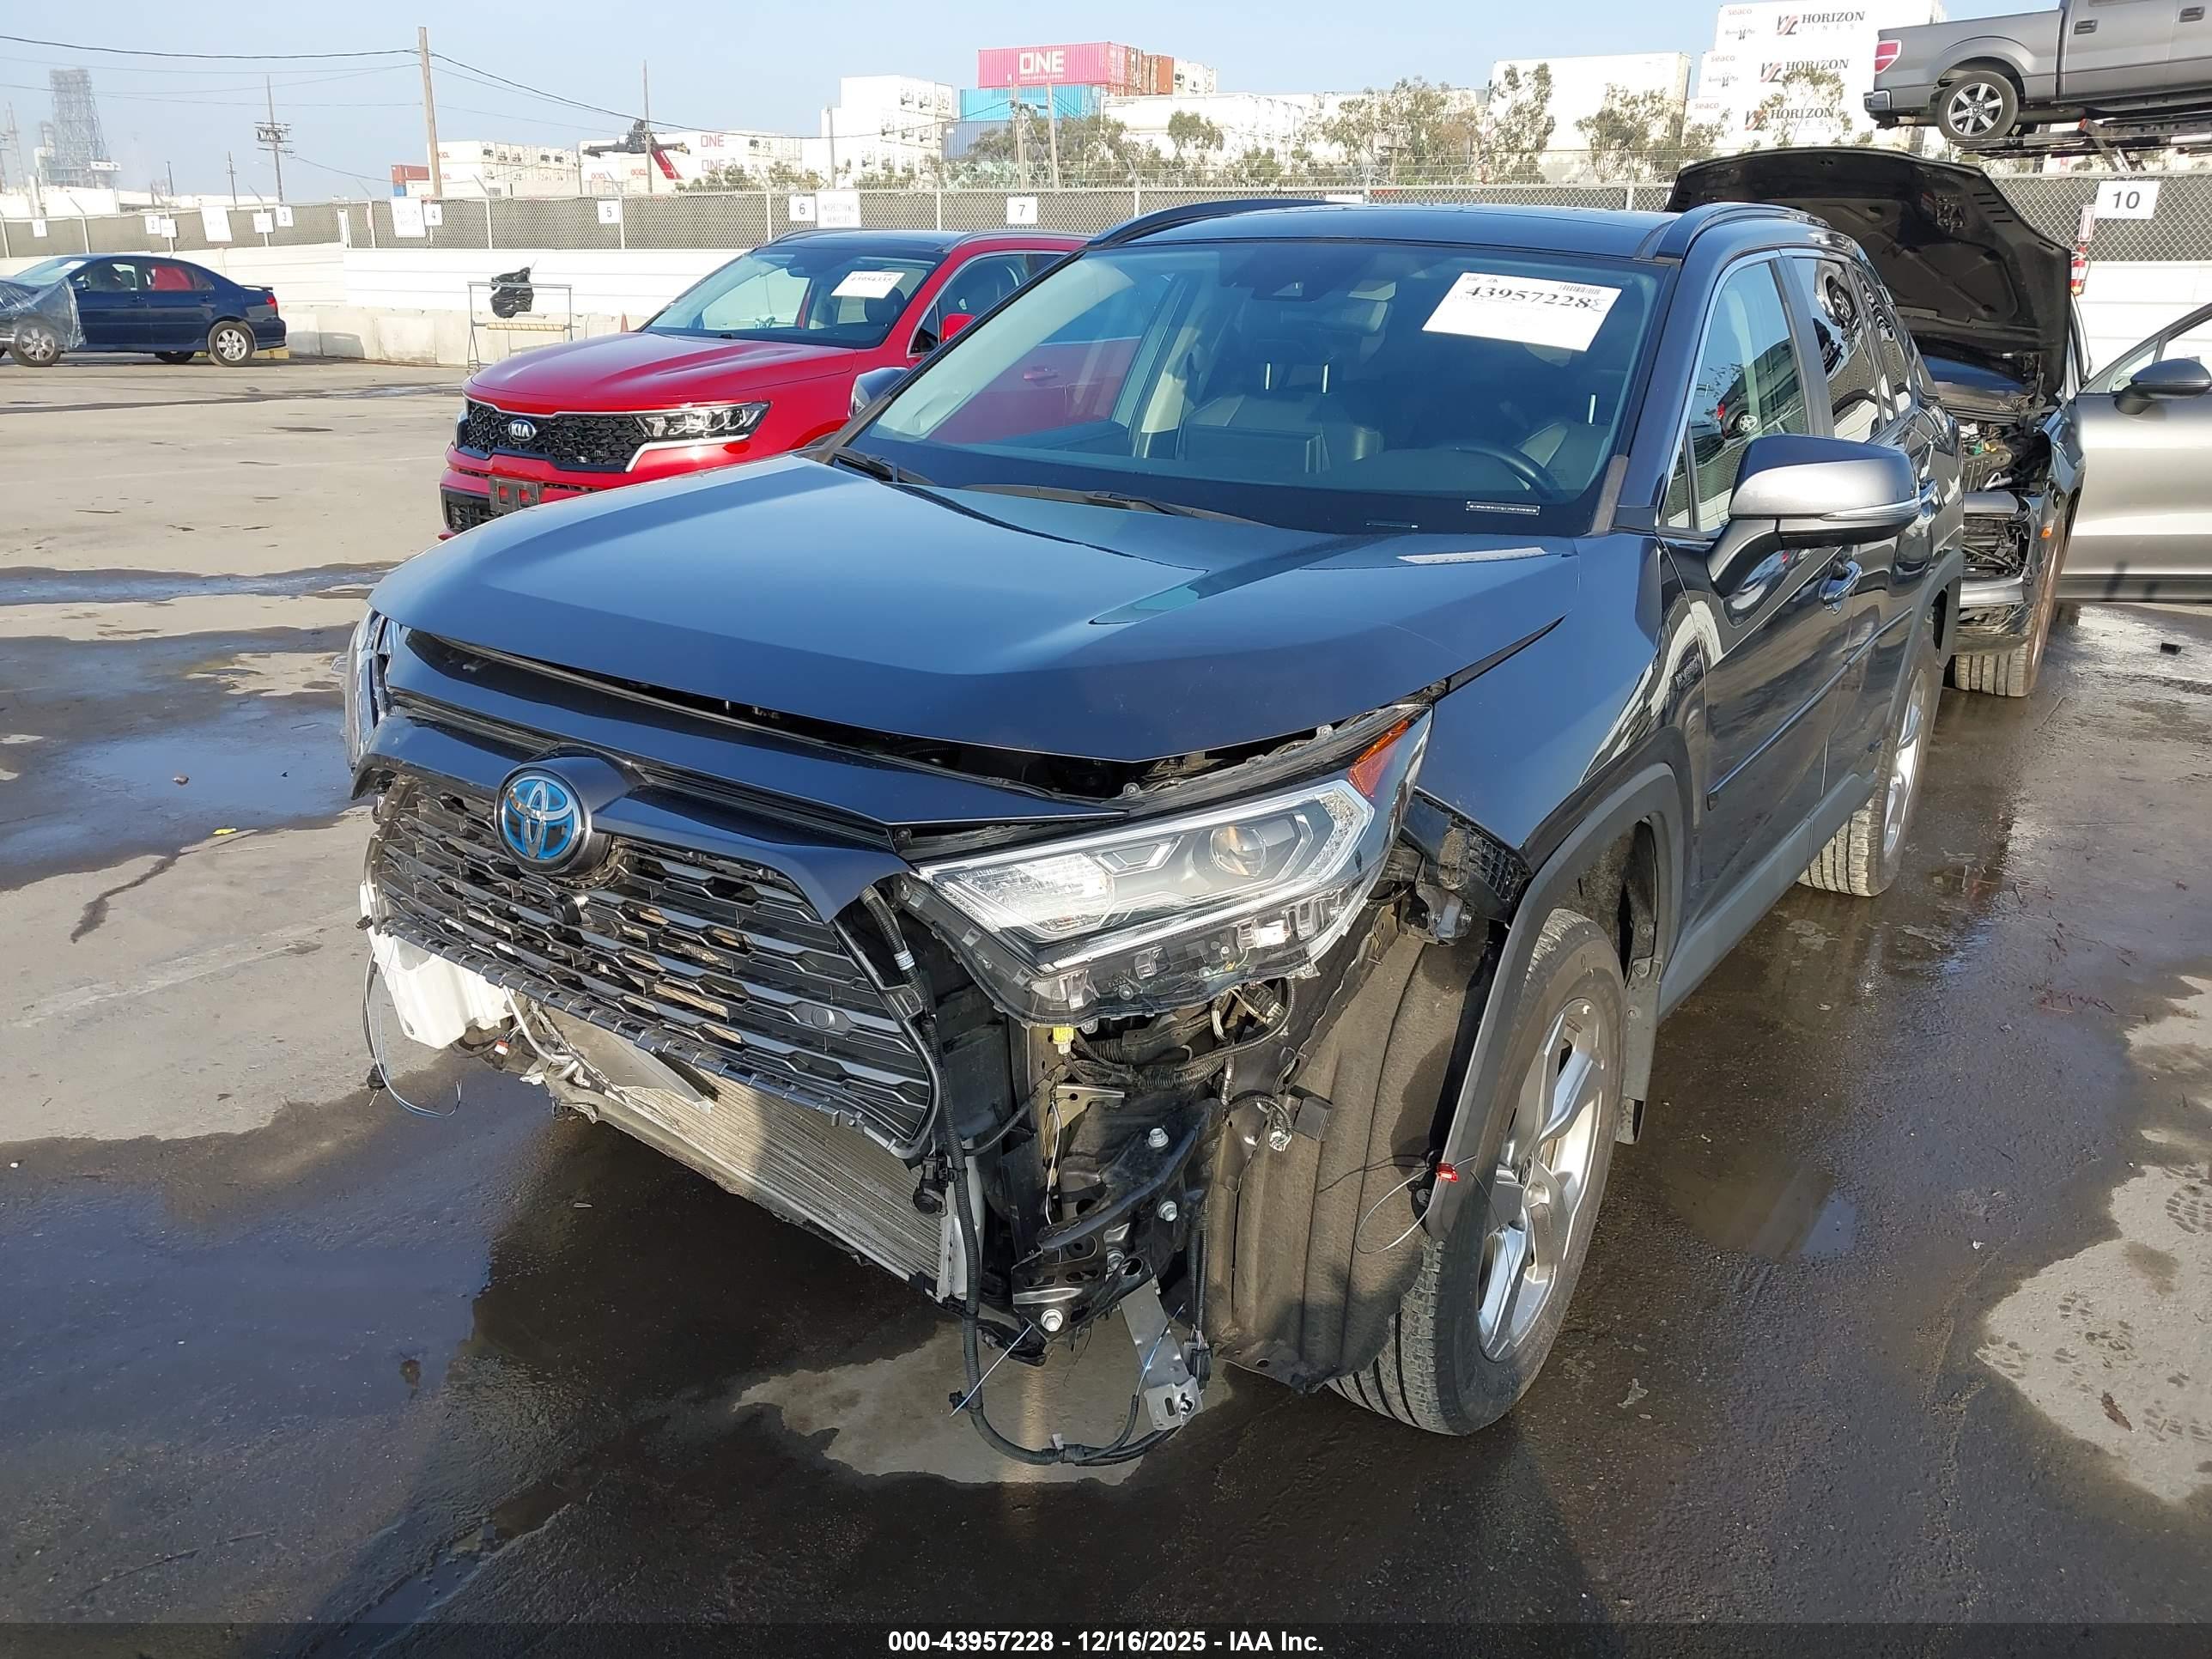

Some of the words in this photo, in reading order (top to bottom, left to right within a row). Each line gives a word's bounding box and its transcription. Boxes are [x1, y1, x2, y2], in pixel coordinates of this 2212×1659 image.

[1728, 8, 1753, 16] seaco
[1802, 11, 1865, 24] HORIZON
[1018, 51, 1065, 75] ONE
[1711, 54, 1735, 63] seaco
[1785, 59, 1849, 71] HORIZON
[1694, 101, 1720, 110] seaco
[1771, 107, 1836, 119] HORIZON
[701, 135, 725, 147] ONE
[702, 160, 726, 172] ONE
[2112, 191, 2141, 210] 10
[431, 210, 436, 220] 4
[606, 206, 612, 217] 5
[799, 203, 805, 215] 6
[1018, 204, 1025, 217] 7
[282, 212, 287, 222] 3
[150, 220, 155, 229] 2
[1465, 285, 1590, 309] 43957228
[512, 423, 530, 437] KIA
